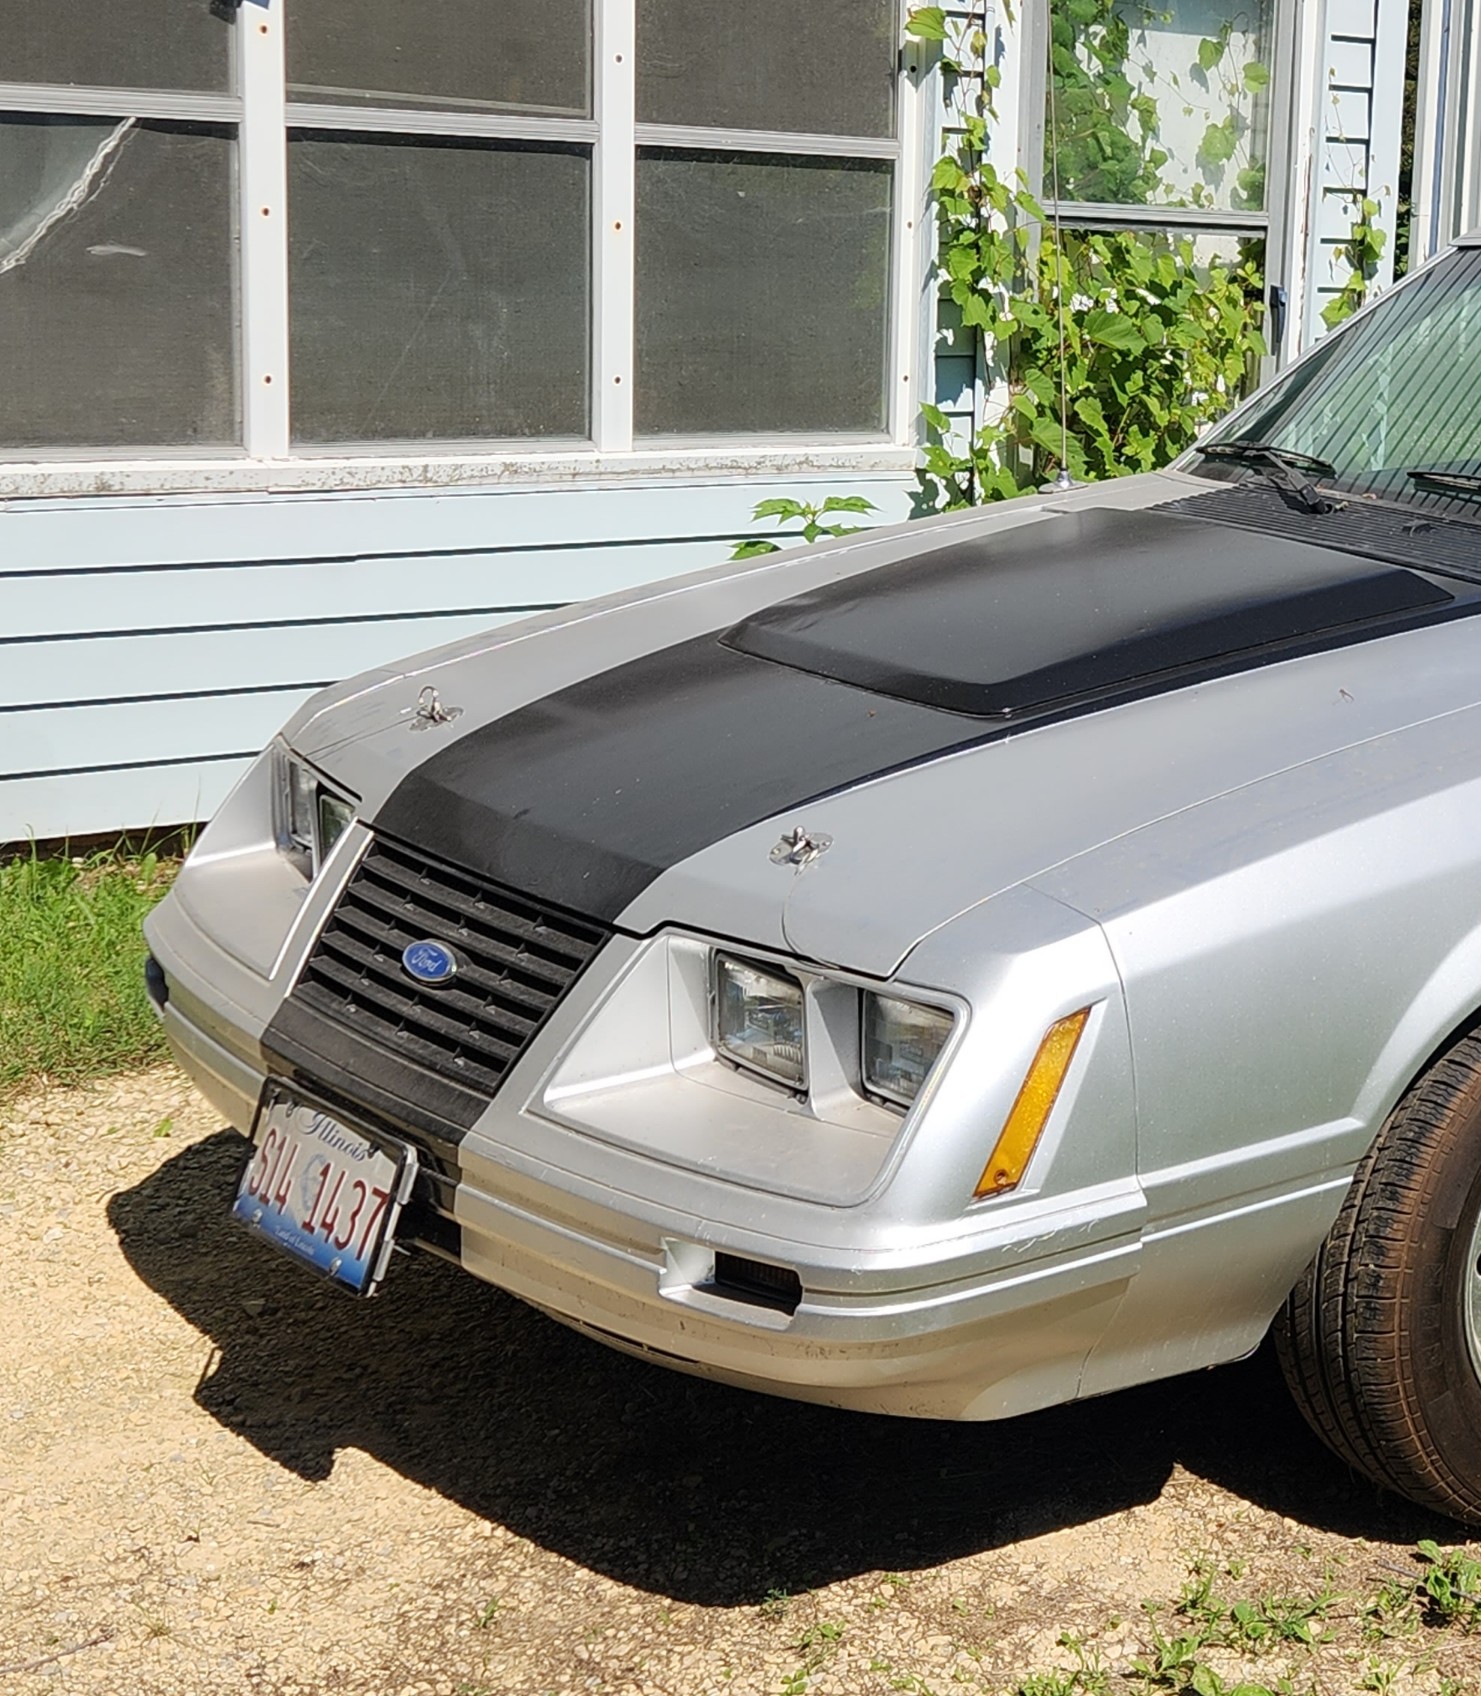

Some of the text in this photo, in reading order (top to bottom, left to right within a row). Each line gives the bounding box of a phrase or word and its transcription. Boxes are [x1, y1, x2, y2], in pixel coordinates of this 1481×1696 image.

[411, 946, 442, 972] Ford
[297, 1110, 369, 1162] Illinois
[301, 1162, 390, 1262] 1437
